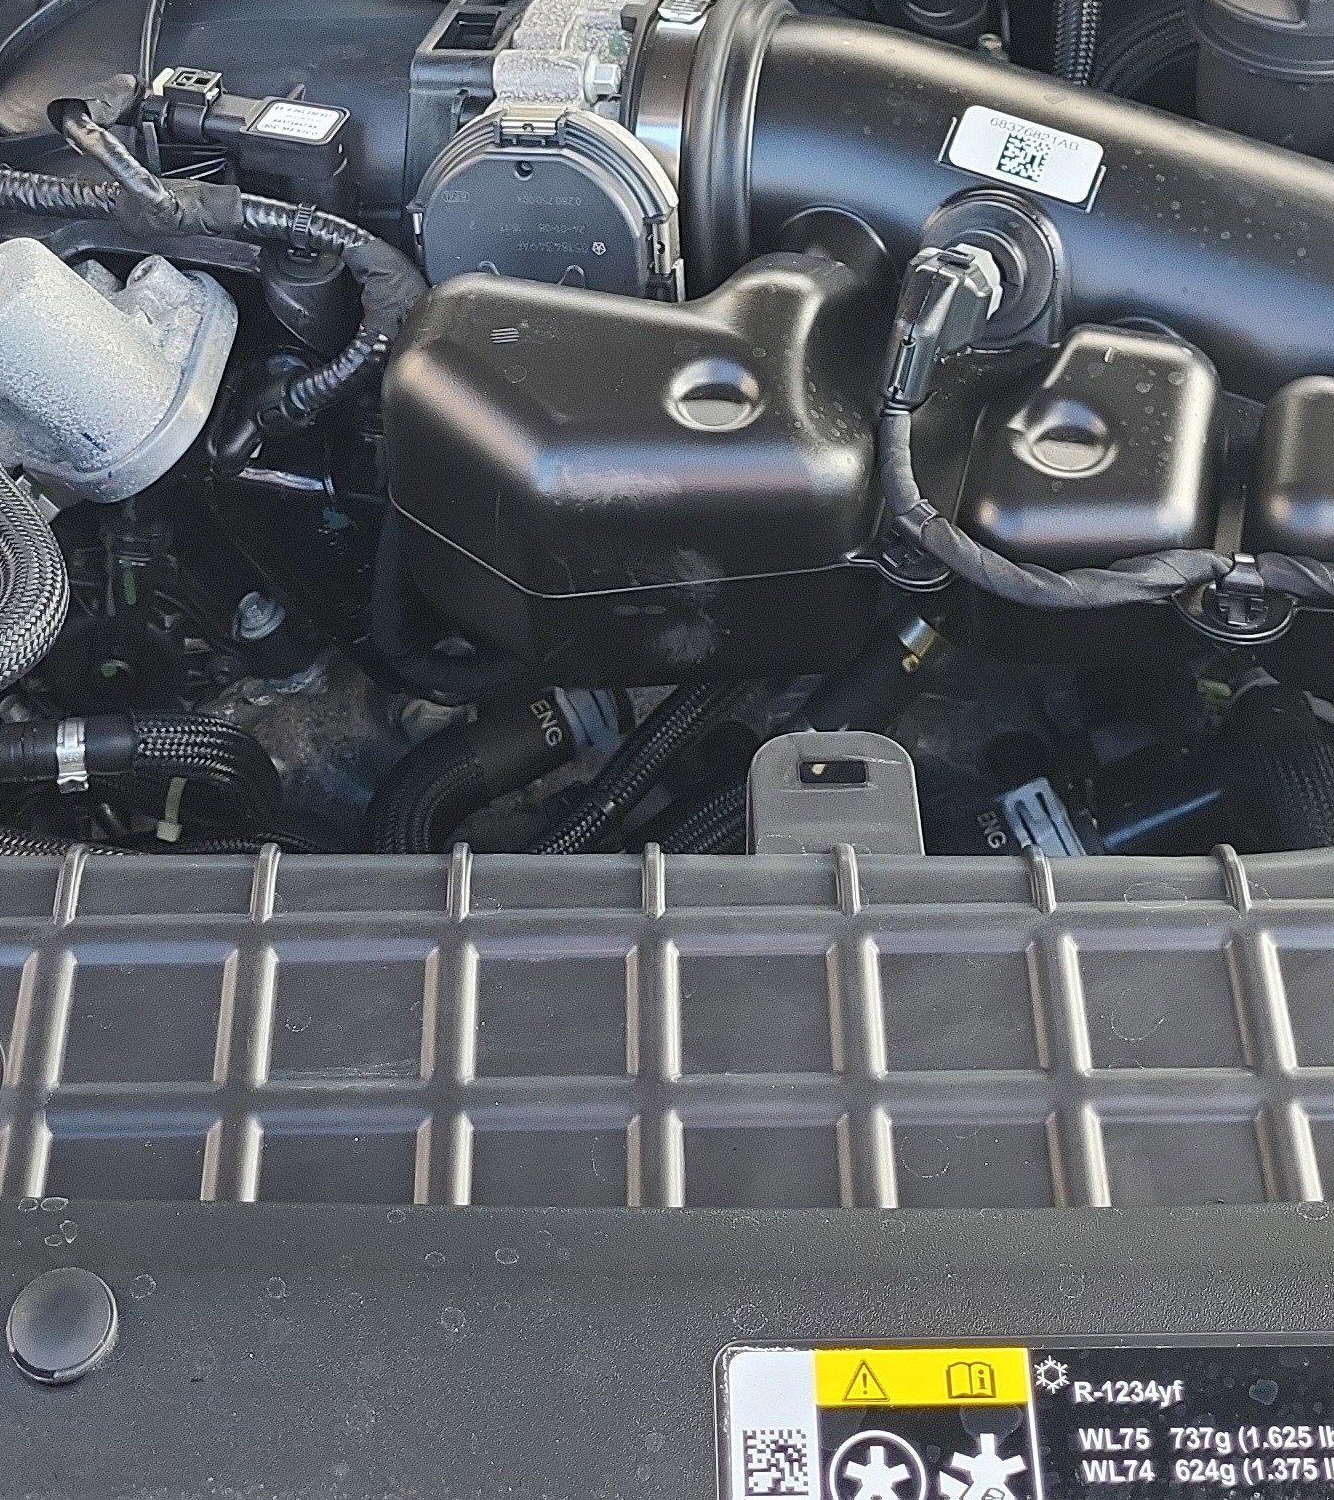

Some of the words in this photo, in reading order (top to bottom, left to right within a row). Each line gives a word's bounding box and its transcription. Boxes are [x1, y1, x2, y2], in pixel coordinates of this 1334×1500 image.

[989, 117, 1079, 151] 68376821AB
[531, 699, 563, 746] ENG
[977, 811, 1006, 848] ENG
[1073, 1380, 1184, 1407] R-1234yf
[1079, 1427, 1151, 1450] WL75
[1170, 1427, 1231, 1452] 737g
[1239, 1426, 1312, 1452] (1.625
[1082, 1459, 1155, 1483] WL74
[1175, 1459, 1237, 1485] 624g
[1244, 1458, 1318, 1484] (1.375
